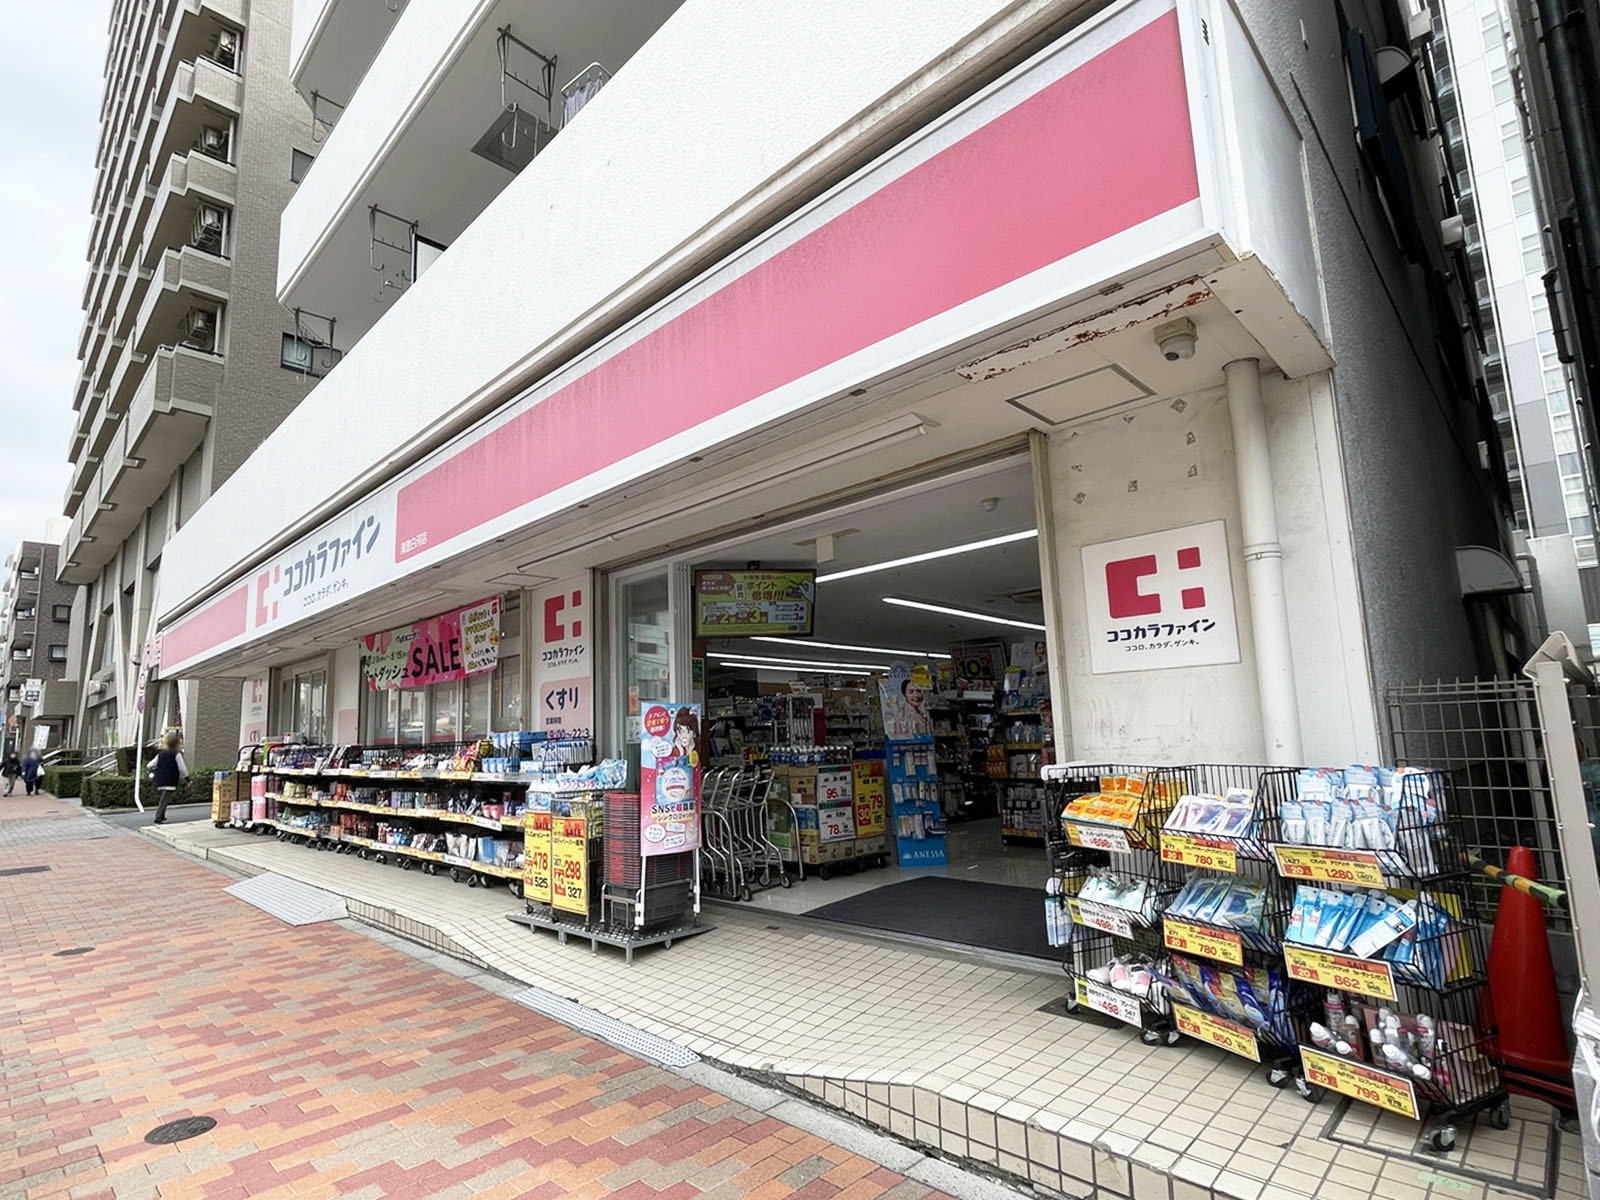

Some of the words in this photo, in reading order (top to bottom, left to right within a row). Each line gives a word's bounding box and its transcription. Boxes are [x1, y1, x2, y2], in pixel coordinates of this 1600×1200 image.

[283, 515, 381, 597] ココカラファイン
[1106, 618, 1216, 643] ココカラファイン
[542, 644, 585, 662] ココカラファイン
[1125, 639, 1200, 652] ココロ、カラダ、ゲンキ。
[411, 637, 462, 678] SALE
[545, 686, 579, 711] くすり
[564, 828, 582, 838] SALE
[533, 851, 548, 871] 478
[912, 850, 945, 859] ANESSA
[1193, 854, 1213, 865] 780
[564, 860, 582, 880] 298
[534, 876, 549, 889] 525
[567, 886, 582, 899] 327
[1198, 944, 1217, 956] 780
[1346, 961, 1370, 971] SALE
[1333, 974, 1361, 990] 862
[1353, 1084, 1380, 1102] 799
